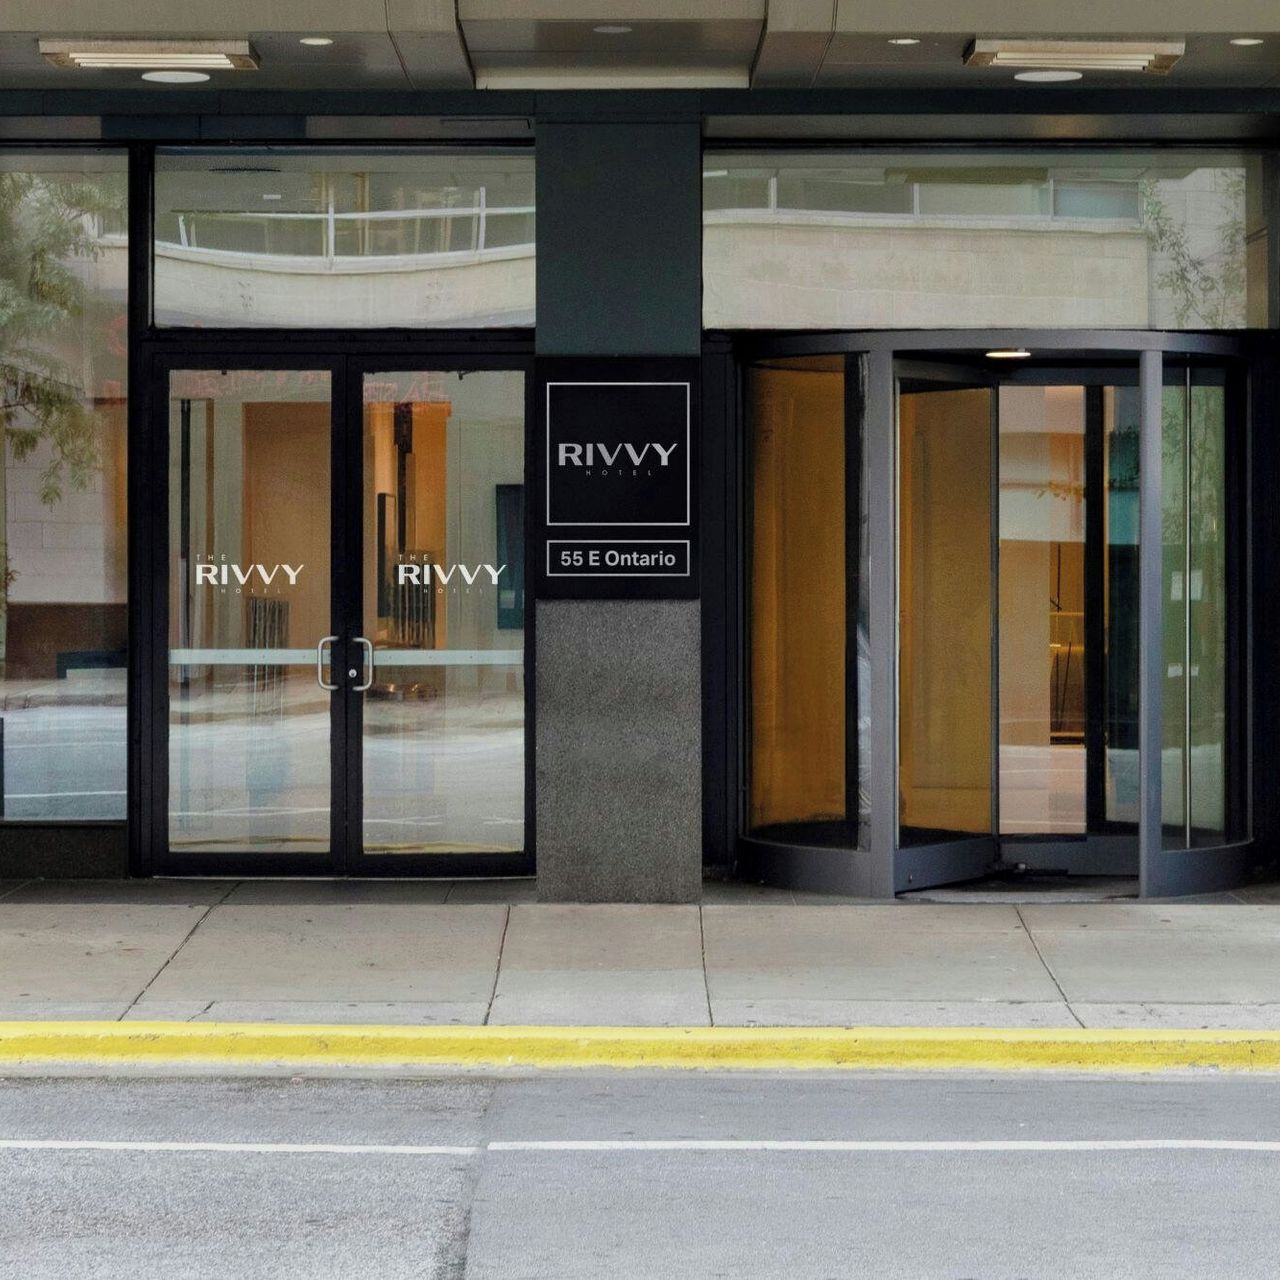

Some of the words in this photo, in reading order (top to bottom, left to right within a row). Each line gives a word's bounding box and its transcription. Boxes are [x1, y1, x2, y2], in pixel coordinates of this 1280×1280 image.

[558, 442, 678, 466] RIVVY
[561, 551, 583, 567] 55
[589, 551, 600, 566] E
[604, 550, 677, 567] Ontario
[196, 564, 304, 585] RIVVY
[398, 564, 507, 585] RIVVY
